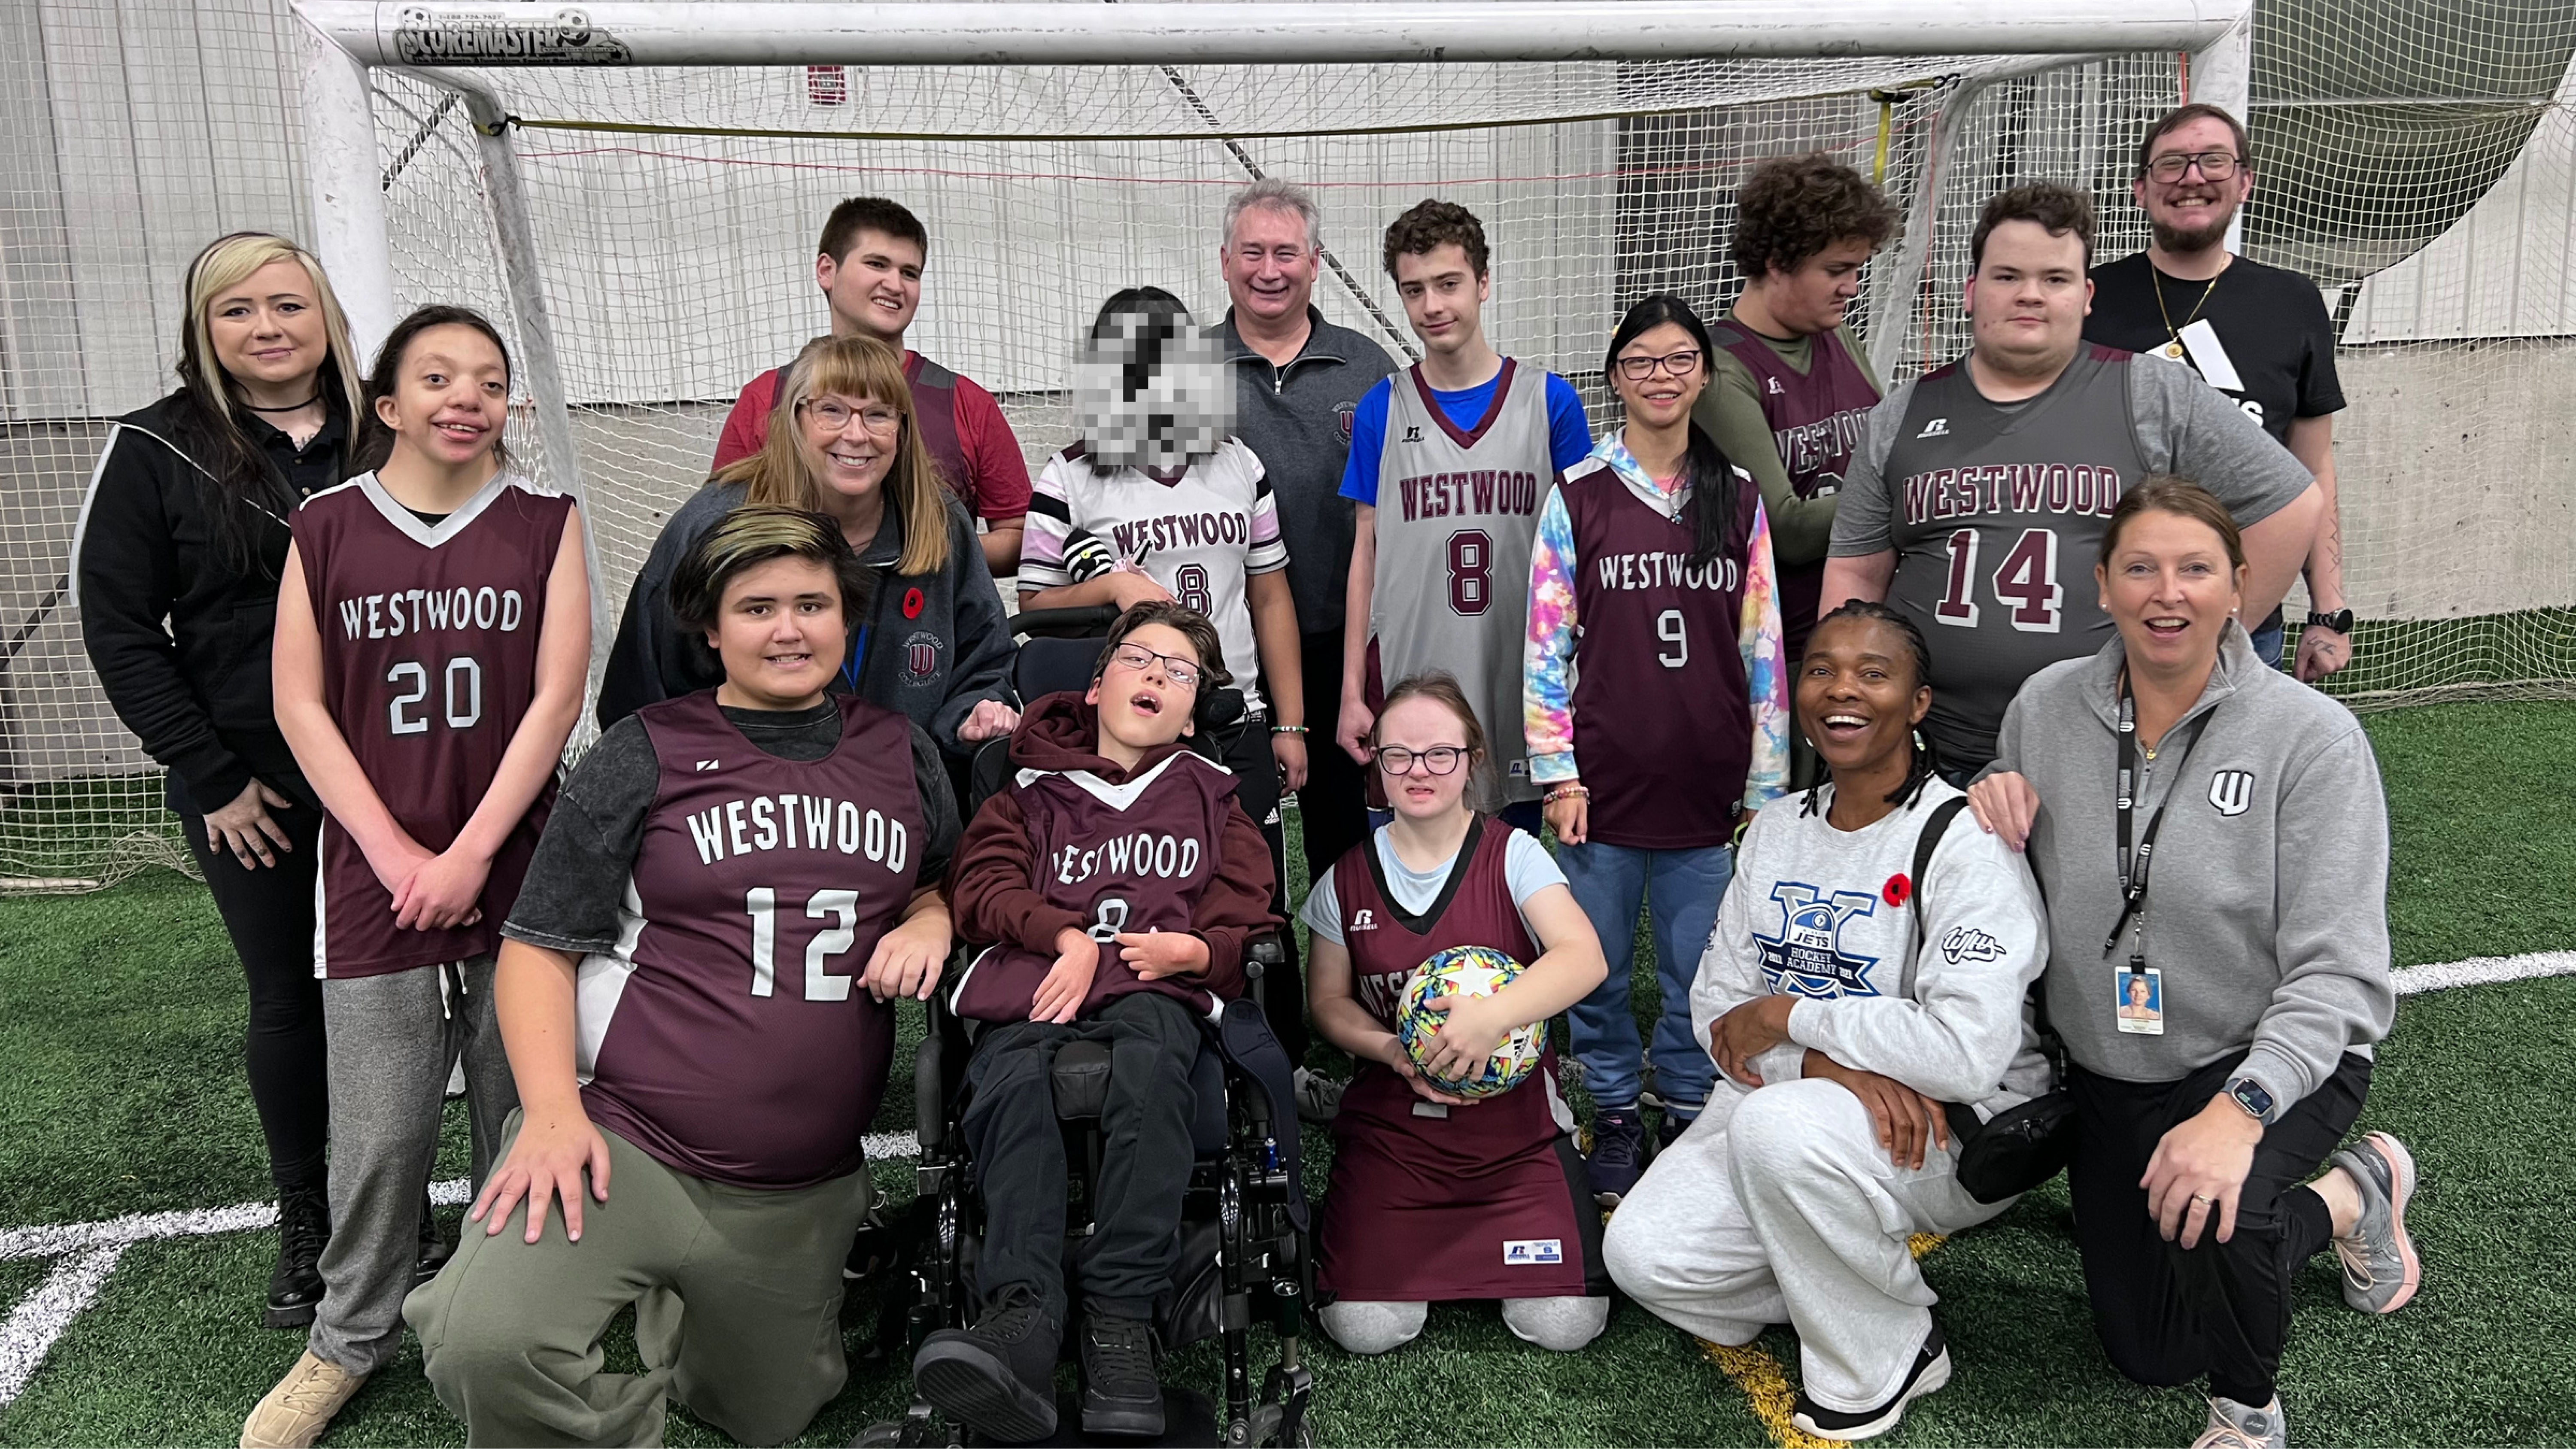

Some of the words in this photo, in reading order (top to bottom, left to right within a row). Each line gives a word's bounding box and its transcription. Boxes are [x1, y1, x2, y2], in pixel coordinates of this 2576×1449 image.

[405, 20, 562, 57] SCOREMASTER
[1400, 471, 1537, 523] WESTWOOD
[1903, 463, 2121, 525] WESTWOOD
[1112, 512, 1247, 558] WESTWOOD
[1175, 563, 1212, 619] 8
[1446, 529, 1493, 617] 8
[1599, 551, 1738, 592] WESTWOOD
[1935, 529, 2064, 633] 14
[339, 586, 522, 641] WESTWOOD
[1658, 610, 1688, 667] 9
[902, 632, 944, 649] WESTWOOD
[388, 657, 480, 735] 20
[687, 794, 906, 873] WESTWOOD
[1053, 832, 1200, 884] ESTWOOD
[746, 887, 859, 1001] 12
[1786, 956, 1837, 975] ACADEMY
[1791, 947, 1832, 963] HOCKEY
[1793, 932, 1829, 948] JETS
